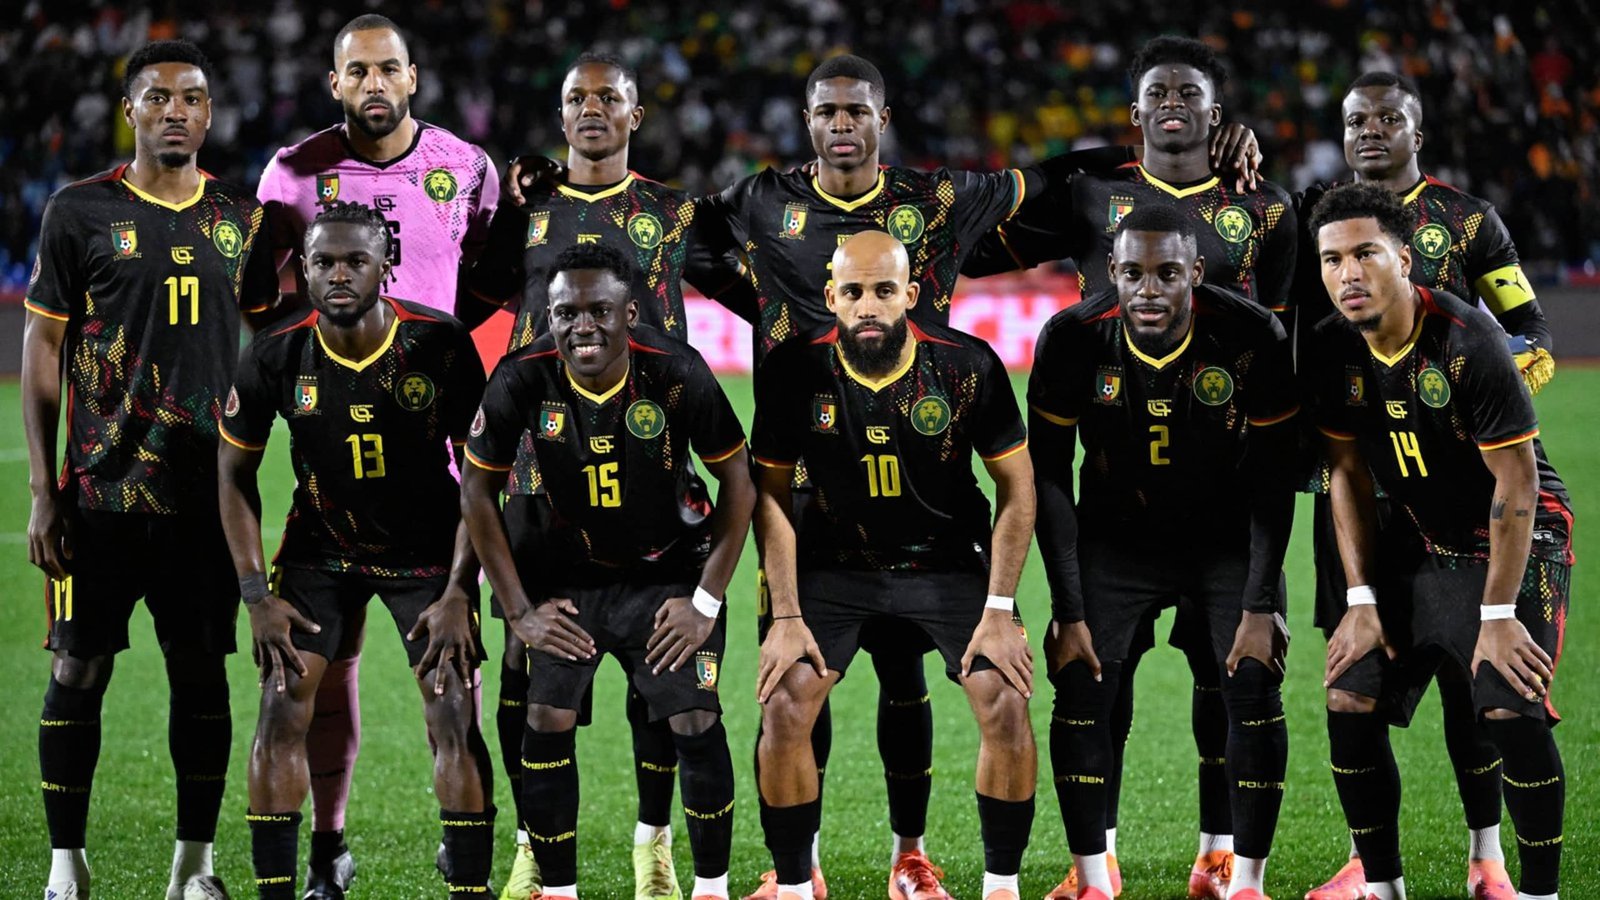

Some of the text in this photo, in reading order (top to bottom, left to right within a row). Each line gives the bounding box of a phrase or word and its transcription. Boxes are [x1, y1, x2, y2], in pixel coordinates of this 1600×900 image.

[163, 276, 199, 325] 17
[345, 434, 385, 479] 13
[1149, 425, 1170, 465] 2
[1389, 431, 1428, 477] 14
[581, 461, 621, 507] 15
[860, 454, 901, 497] 10
